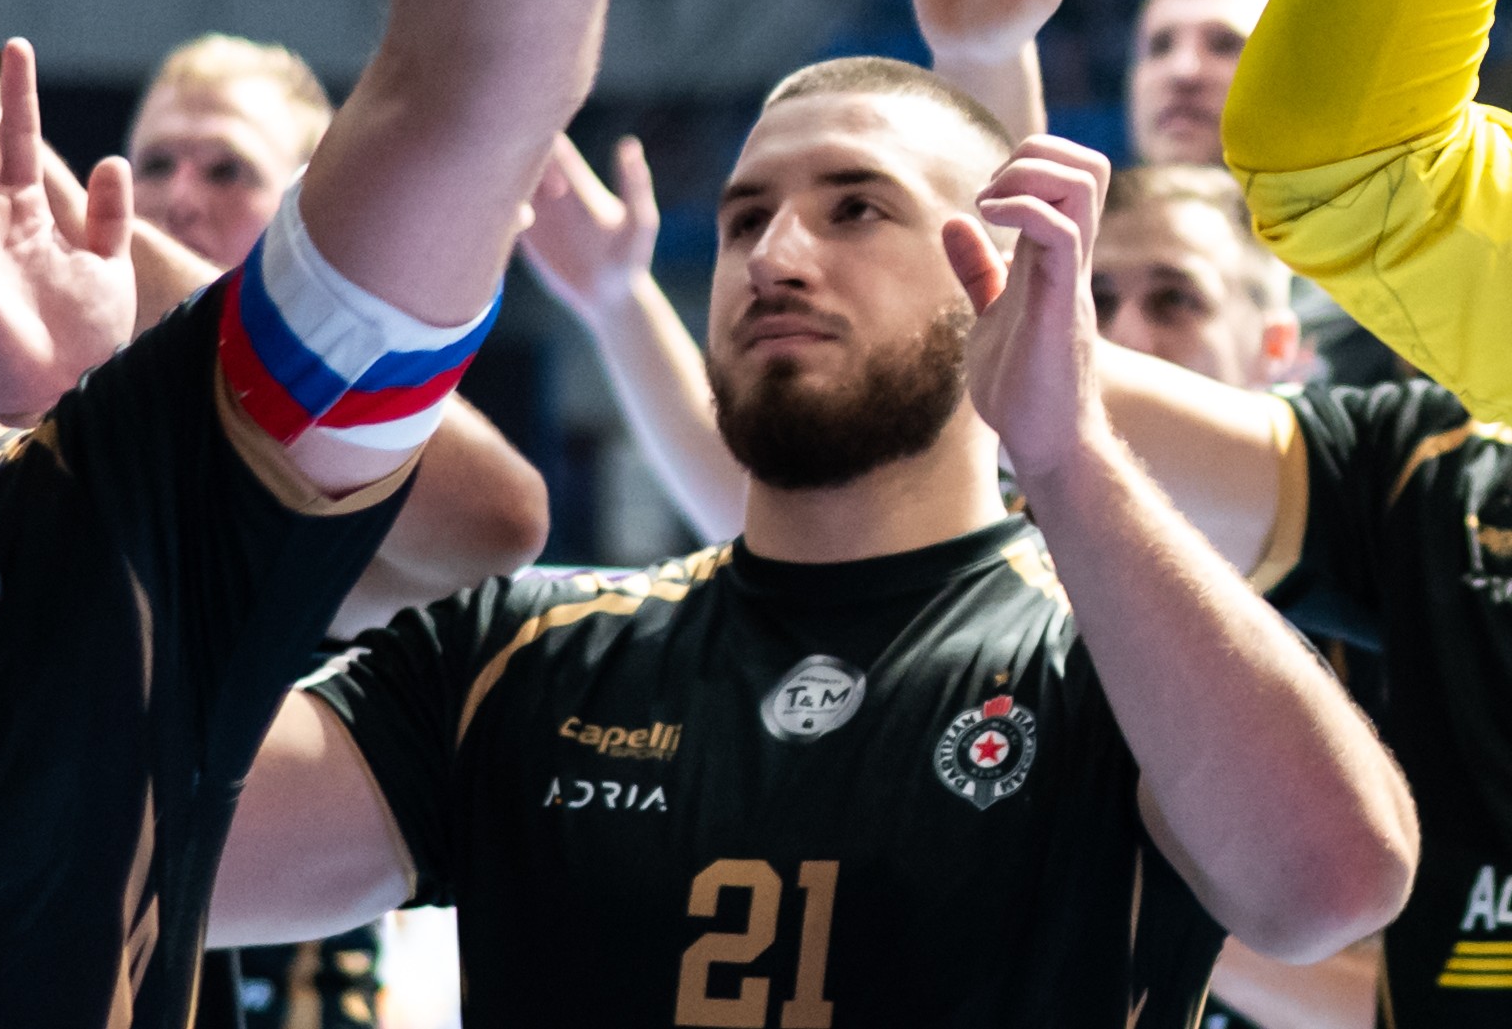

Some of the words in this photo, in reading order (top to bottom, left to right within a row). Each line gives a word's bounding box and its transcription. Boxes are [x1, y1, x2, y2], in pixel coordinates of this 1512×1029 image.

[786, 685, 851, 707] T&M
[558, 716, 683, 753] capelli
[543, 777, 668, 811] ADRIA
[675, 859, 840, 1029] 21
